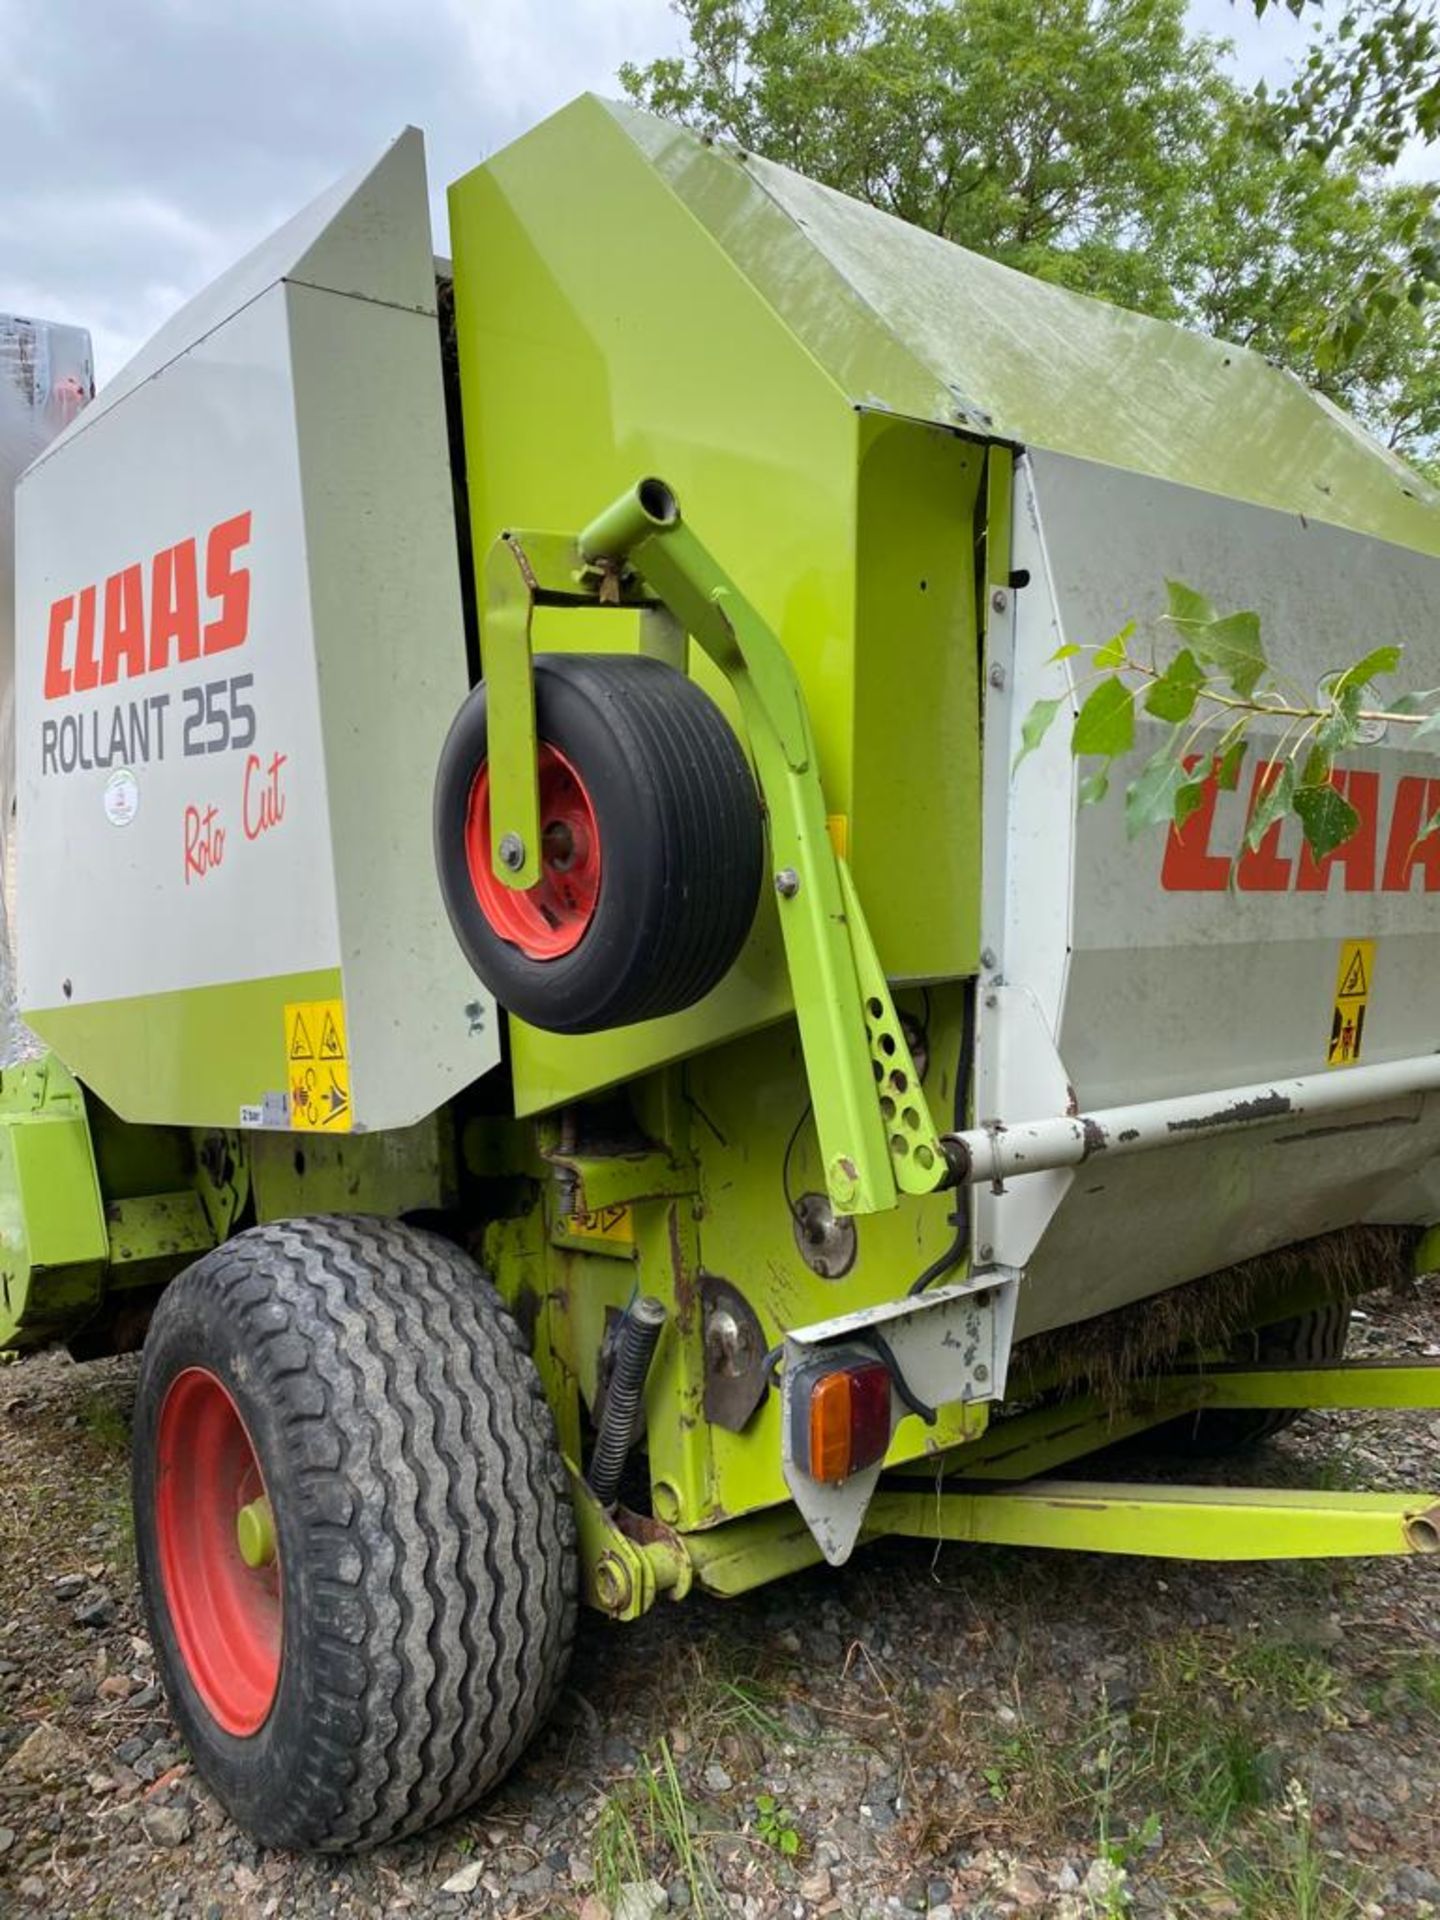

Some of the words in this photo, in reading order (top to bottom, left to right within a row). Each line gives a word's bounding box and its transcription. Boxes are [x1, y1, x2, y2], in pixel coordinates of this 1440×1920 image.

[44, 511, 252, 700] CLAAS
[42, 693, 170, 776] ROLLANT
[183, 673, 256, 757] 255
[184, 804, 226, 885] Roto
[242, 751, 287, 840] Cut
